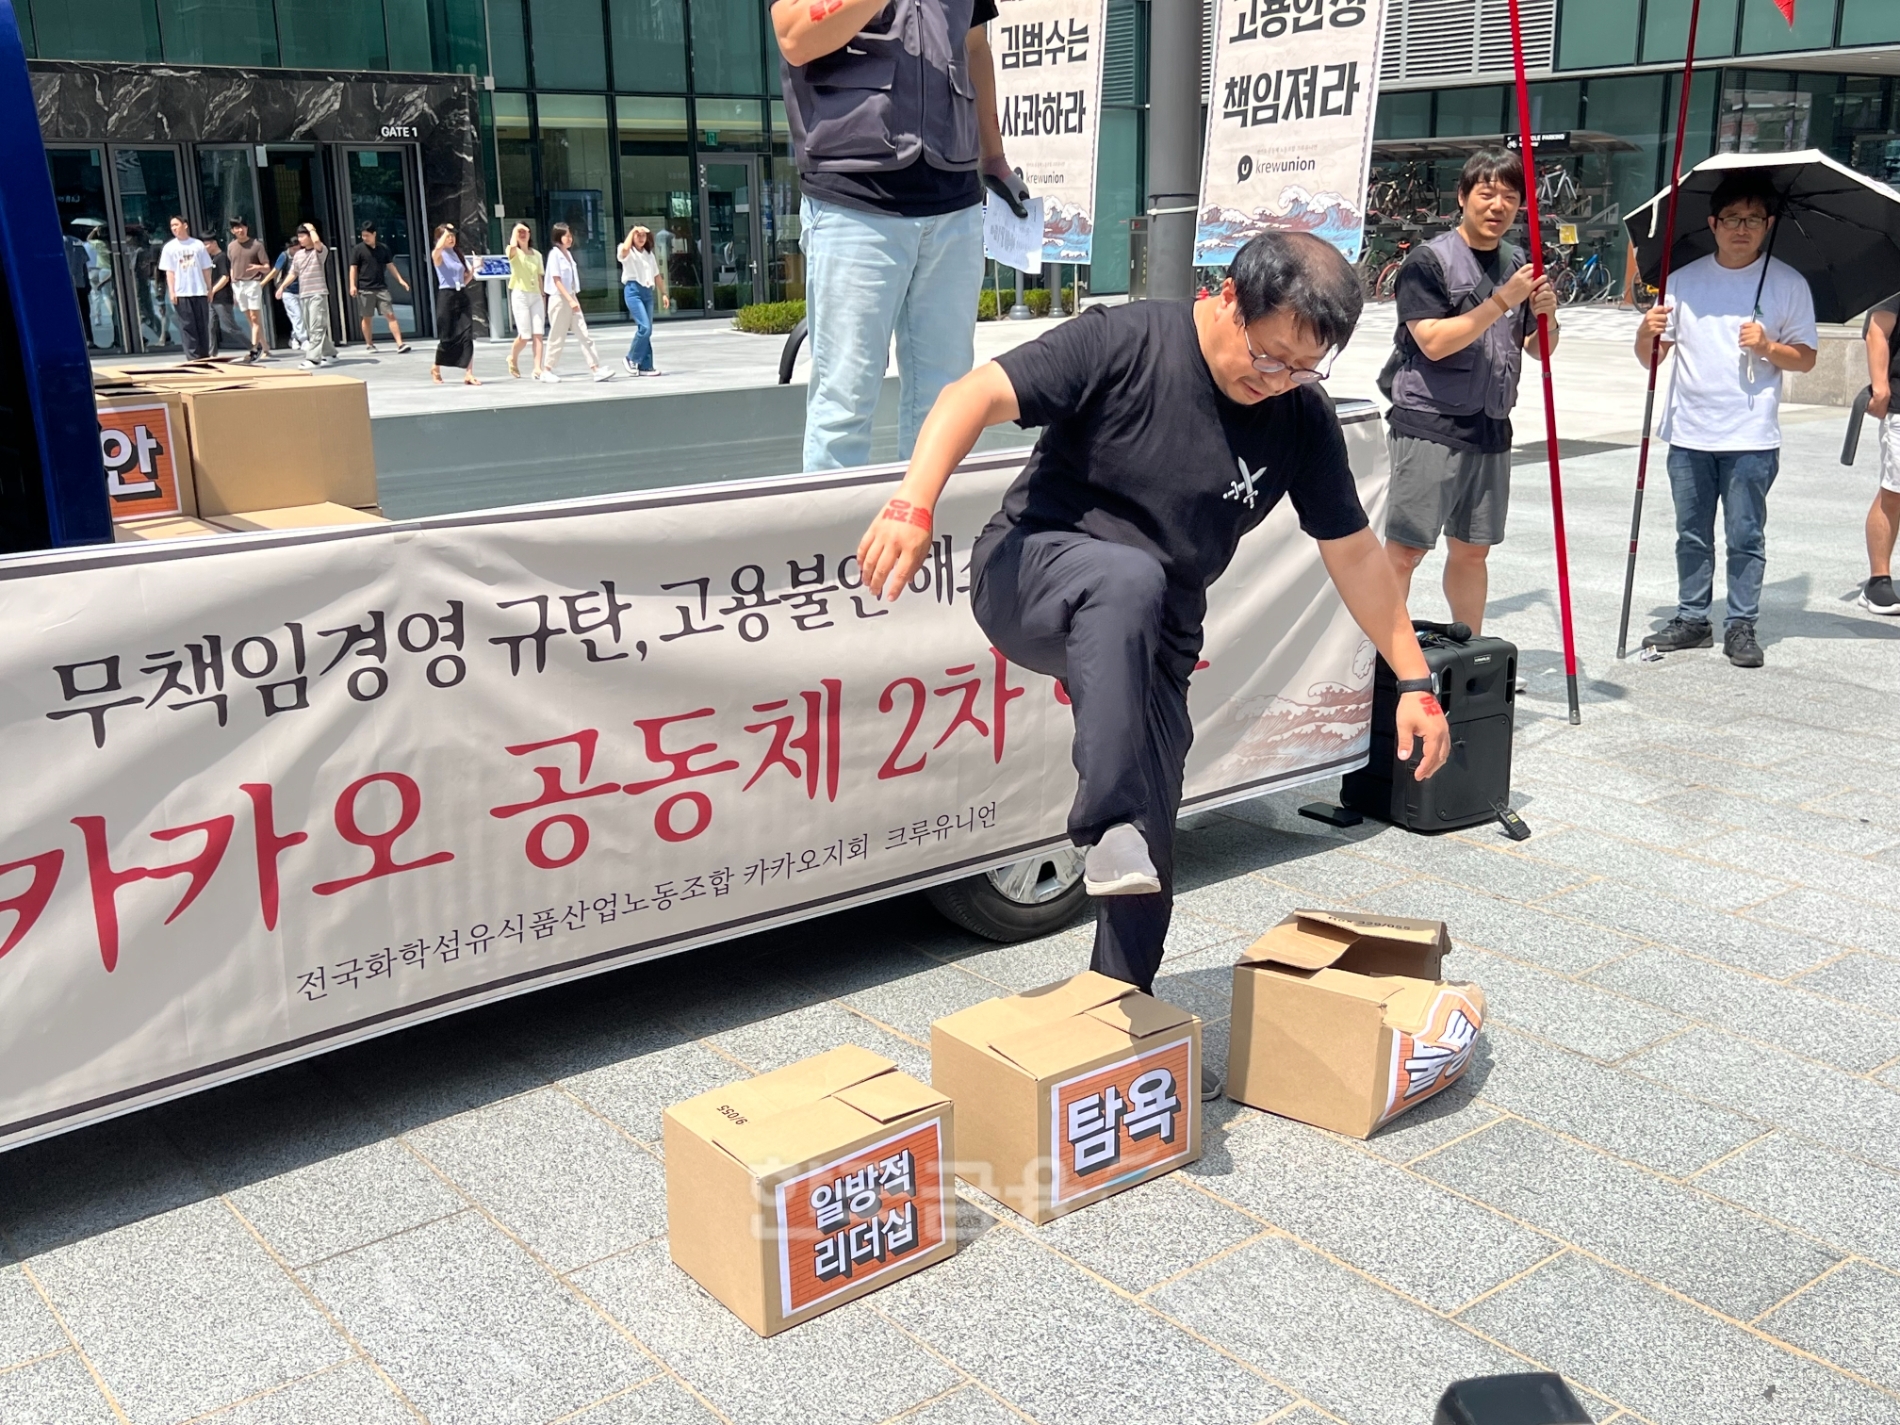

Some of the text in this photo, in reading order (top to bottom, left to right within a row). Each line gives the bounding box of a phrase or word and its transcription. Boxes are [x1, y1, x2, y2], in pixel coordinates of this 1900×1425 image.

[1001, 18, 1089, 70] 김범수는
[1001, 90, 1086, 137] 사과하라
[1223, 61, 1360, 128] 책임져라
[381, 126, 418, 138] GATE 1
[1255, 156, 1316, 174] krewunion
[1026, 171, 1065, 185] krewunion
[46, 600, 467, 749] 무책임경영
[488, 580, 648, 677] 규탄,
[489, 678, 842, 869] 공동체
[877, 646, 1025, 780] 2차
[296, 801, 997, 1002] 전국화학섬유식품산업노동조합 카카오지회 크루유니언
[1067, 1067, 1181, 1178] 탐욕
[810, 1148, 916, 1235] 일방적
[814, 1200, 919, 1282] 리더십
